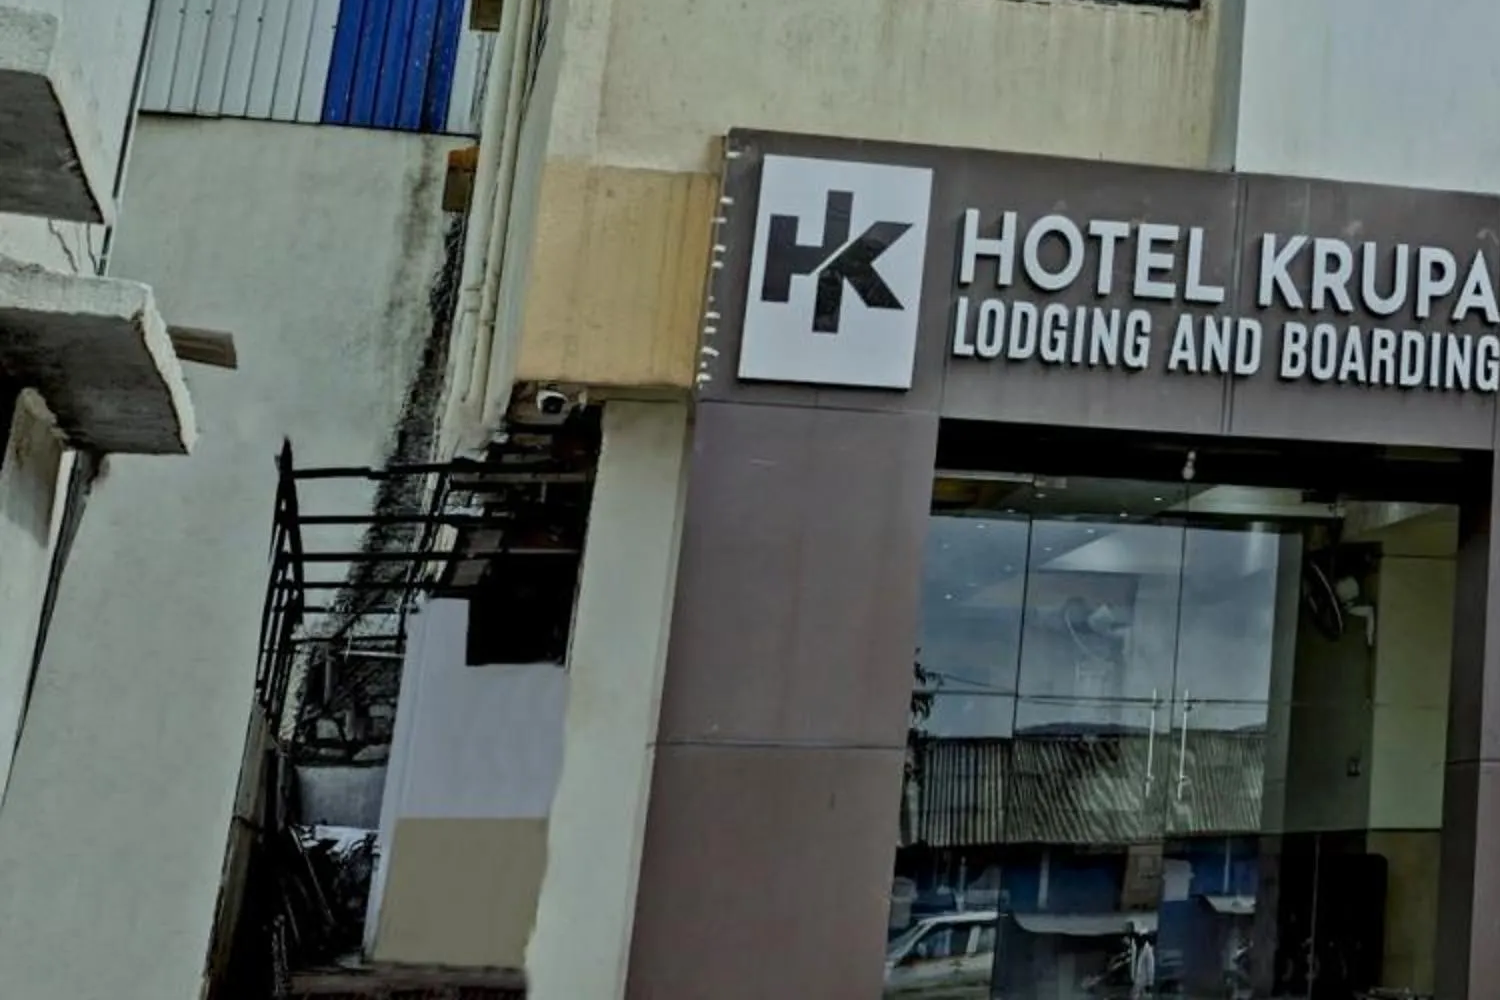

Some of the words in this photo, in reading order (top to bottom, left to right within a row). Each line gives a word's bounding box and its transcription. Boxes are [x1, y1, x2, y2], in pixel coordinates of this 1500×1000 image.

[958, 207, 1225, 303] HOTEL
[1258, 232, 1500, 323] KRUPA
[952, 296, 1152, 369] LODGING
[1168, 313, 1262, 376] AND
[1280, 321, 1500, 392] BOARDING
